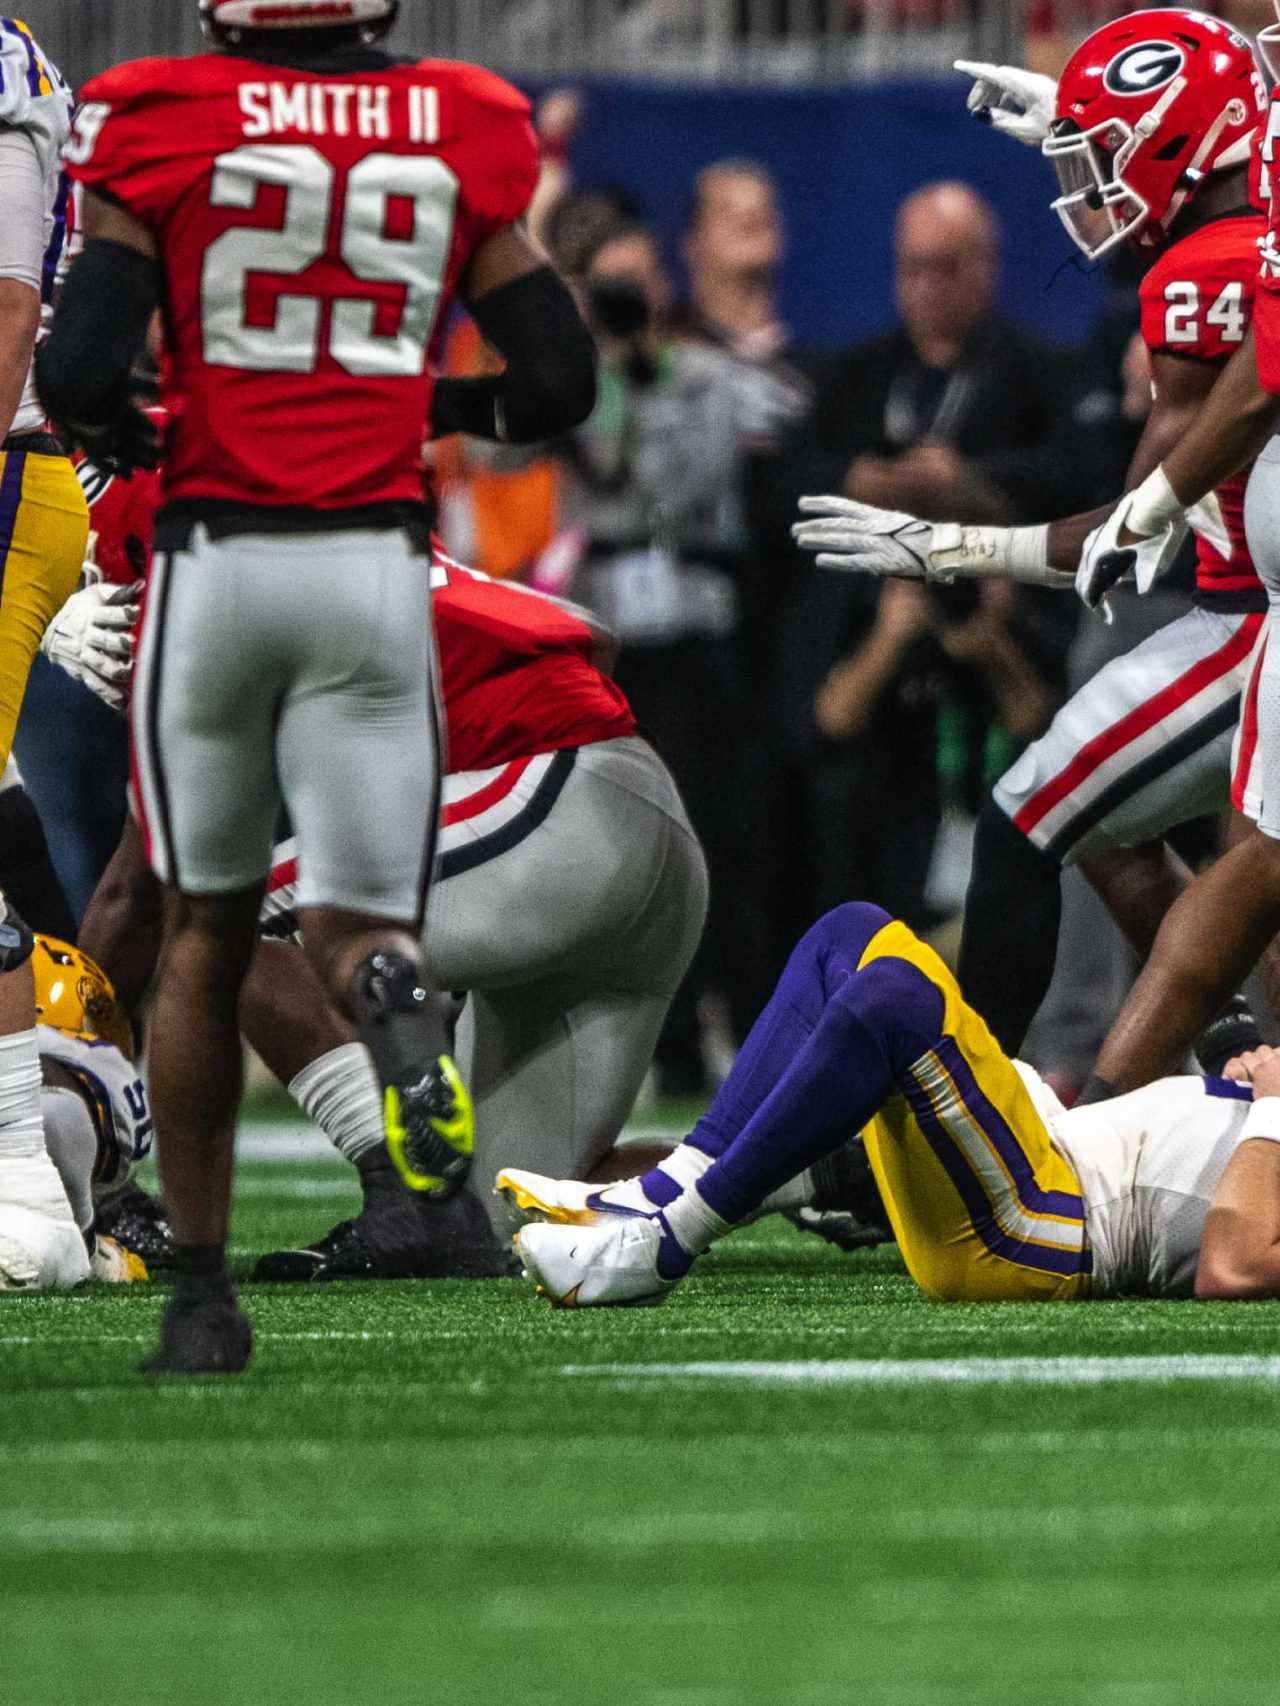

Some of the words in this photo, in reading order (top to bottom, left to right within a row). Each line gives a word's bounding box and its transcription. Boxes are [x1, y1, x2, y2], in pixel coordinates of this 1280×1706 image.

[1112, 43, 1184, 91] G
[60, 101, 112, 165] 9
[238, 81, 391, 140] SMITH
[408, 85, 440, 144] II
[202, 143, 460, 377] 29
[1164, 281, 1245, 342] 24
